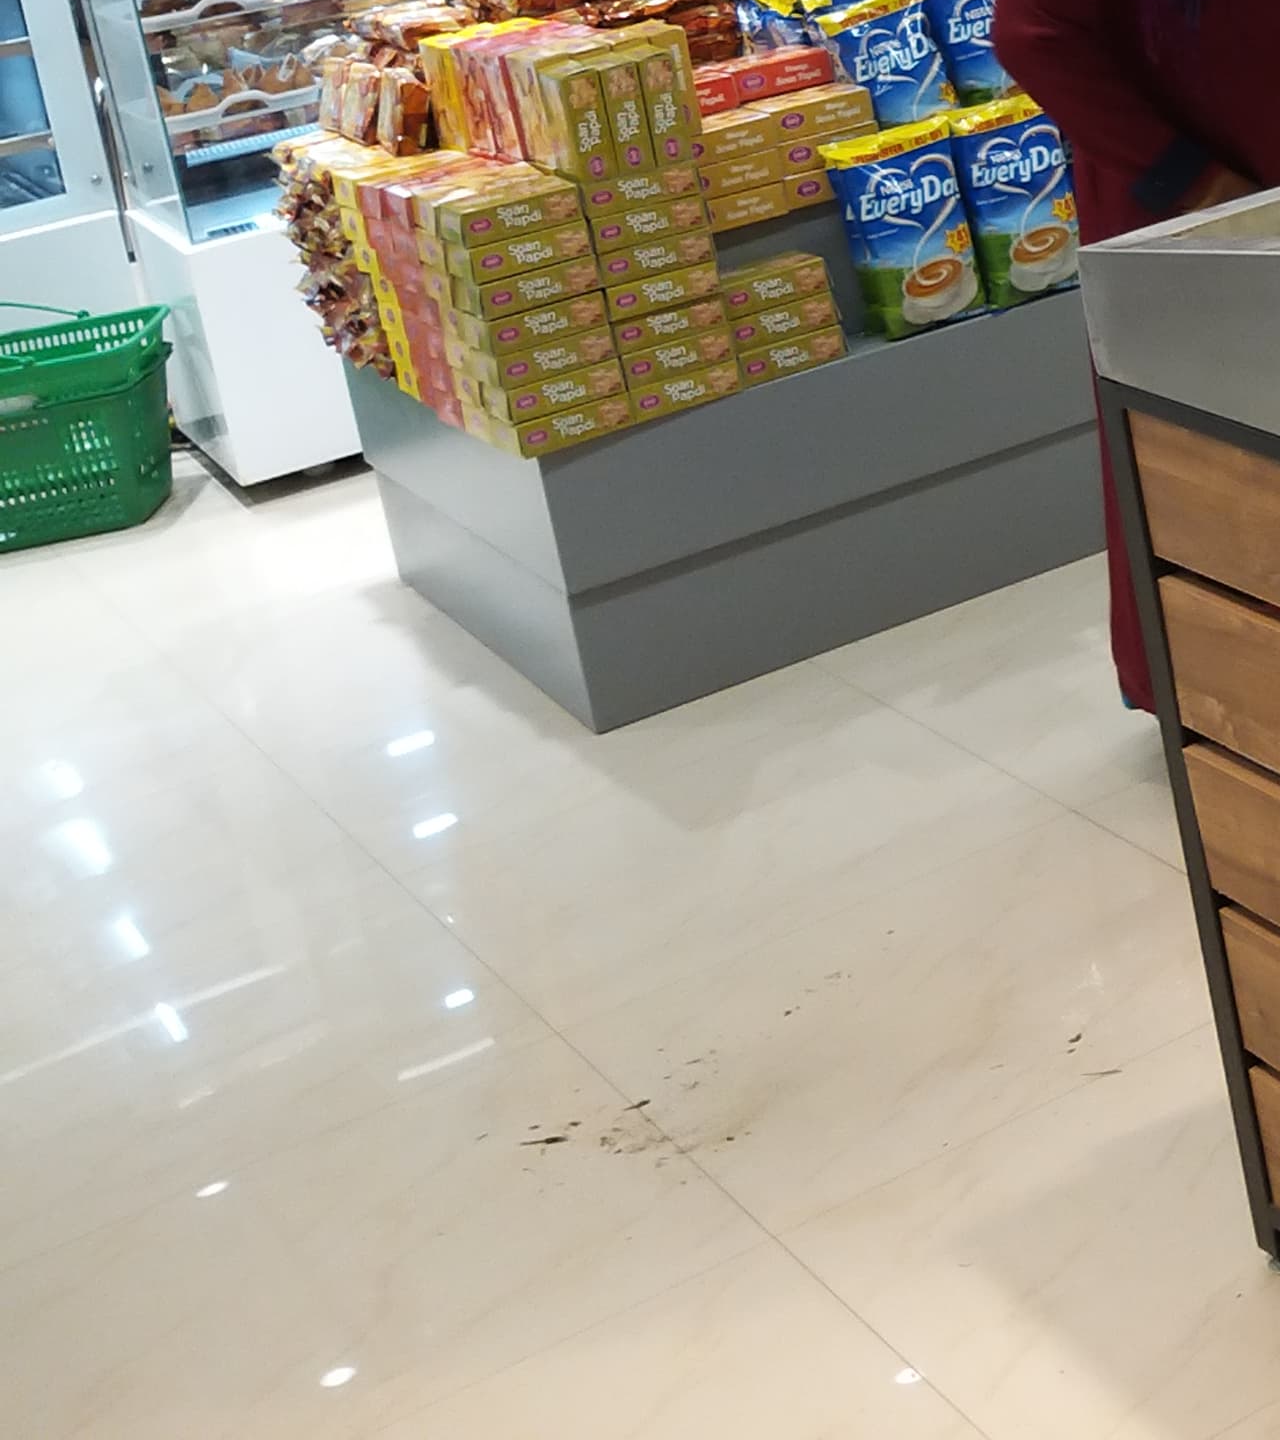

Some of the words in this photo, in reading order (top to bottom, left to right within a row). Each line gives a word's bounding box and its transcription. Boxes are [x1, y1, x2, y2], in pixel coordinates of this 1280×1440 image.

[617, 177, 649, 192] Soan
[497, 203, 529, 219] Soan
[625, 211, 657, 226] Soan
[508, 240, 541, 256] Soan
[633, 246, 665, 261] Soan
[518, 277, 550, 292] Soan
[642, 280, 673, 295] Soan
[752, 277, 782, 293] Soan
[524, 311, 556, 327] Soan
[646, 312, 677, 327] Soan
[759, 311, 789, 326] Soan
[533, 347, 566, 363] Soan
[655, 345, 687, 361] Soan
[769, 346, 799, 361] Soan
[542, 381, 574, 396] Soan
[663, 379, 694, 395] Soan
[552, 414, 584, 430] Soan
